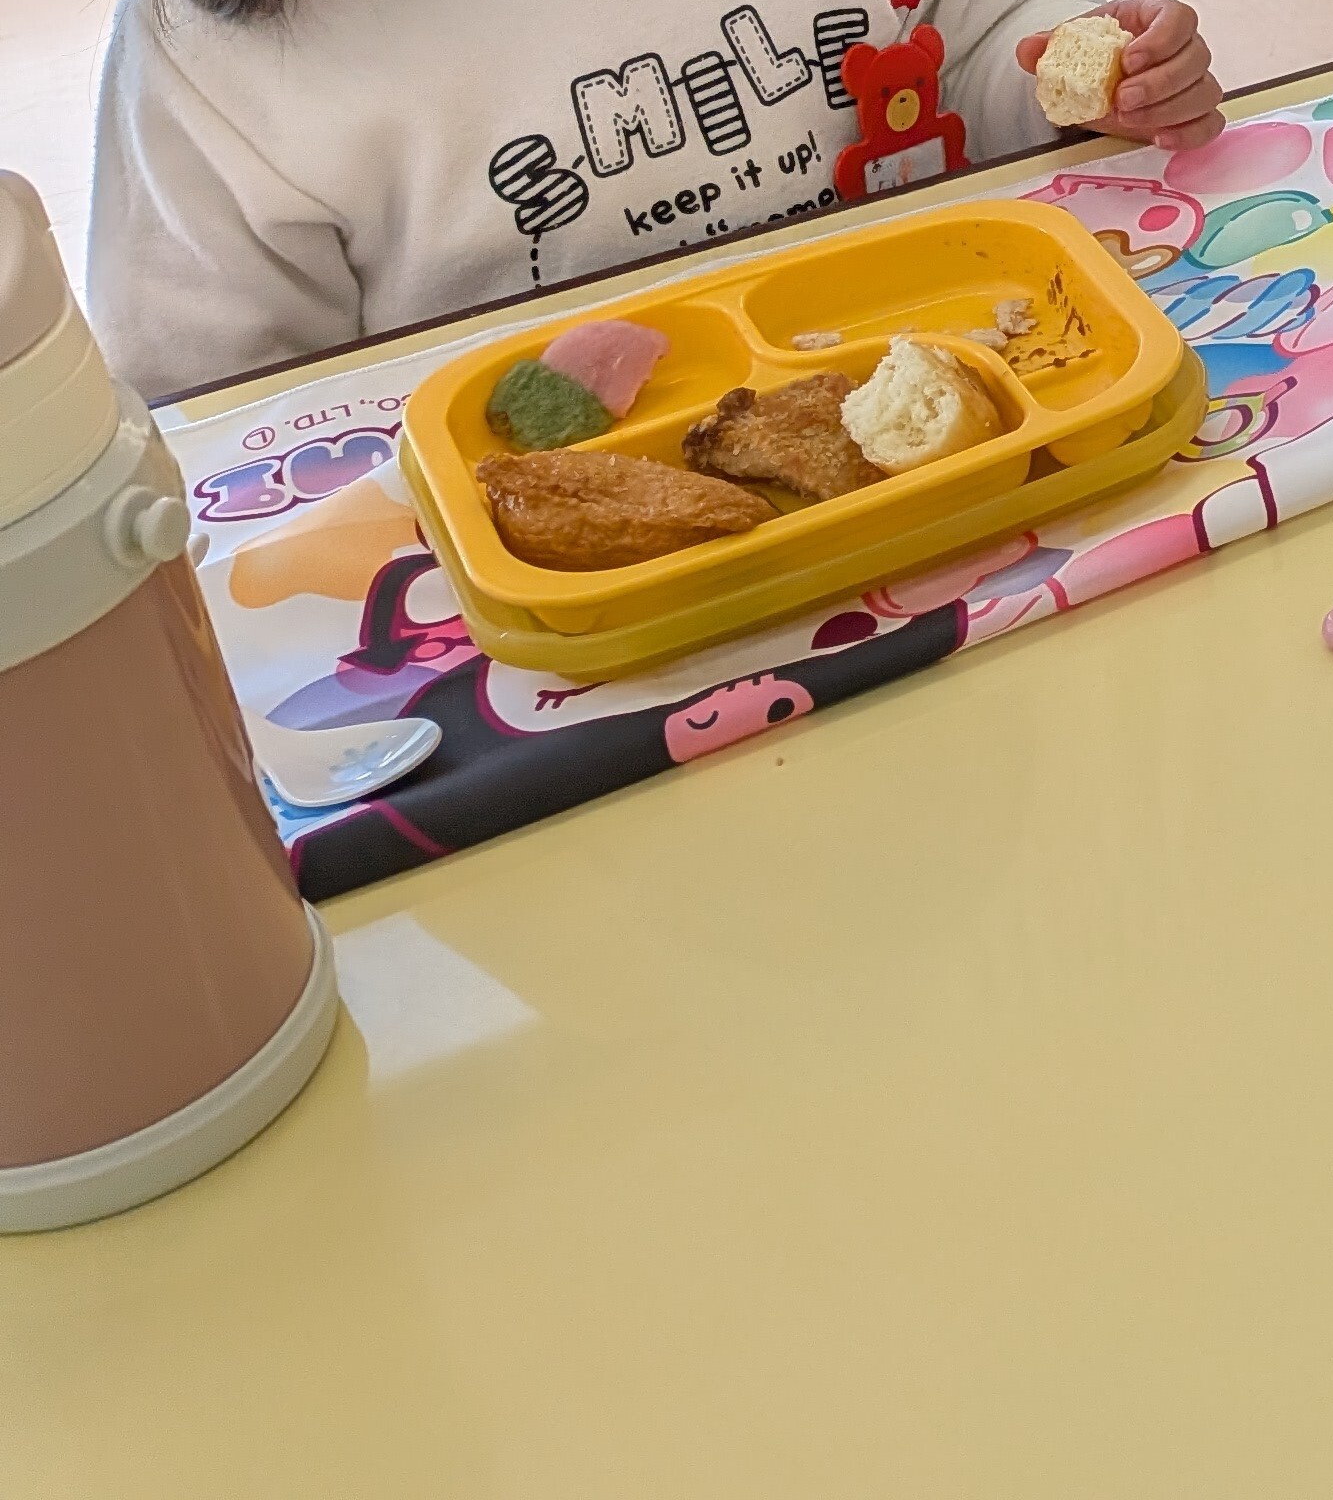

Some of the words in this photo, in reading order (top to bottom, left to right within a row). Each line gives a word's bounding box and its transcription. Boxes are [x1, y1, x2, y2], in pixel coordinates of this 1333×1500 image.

[489, 4, 869, 236] SMILE
[624, 182, 721, 236] keep
[730, 159, 762, 190] it
[778, 130, 823, 175] up!
[284, 404, 352, 431] LTD.
